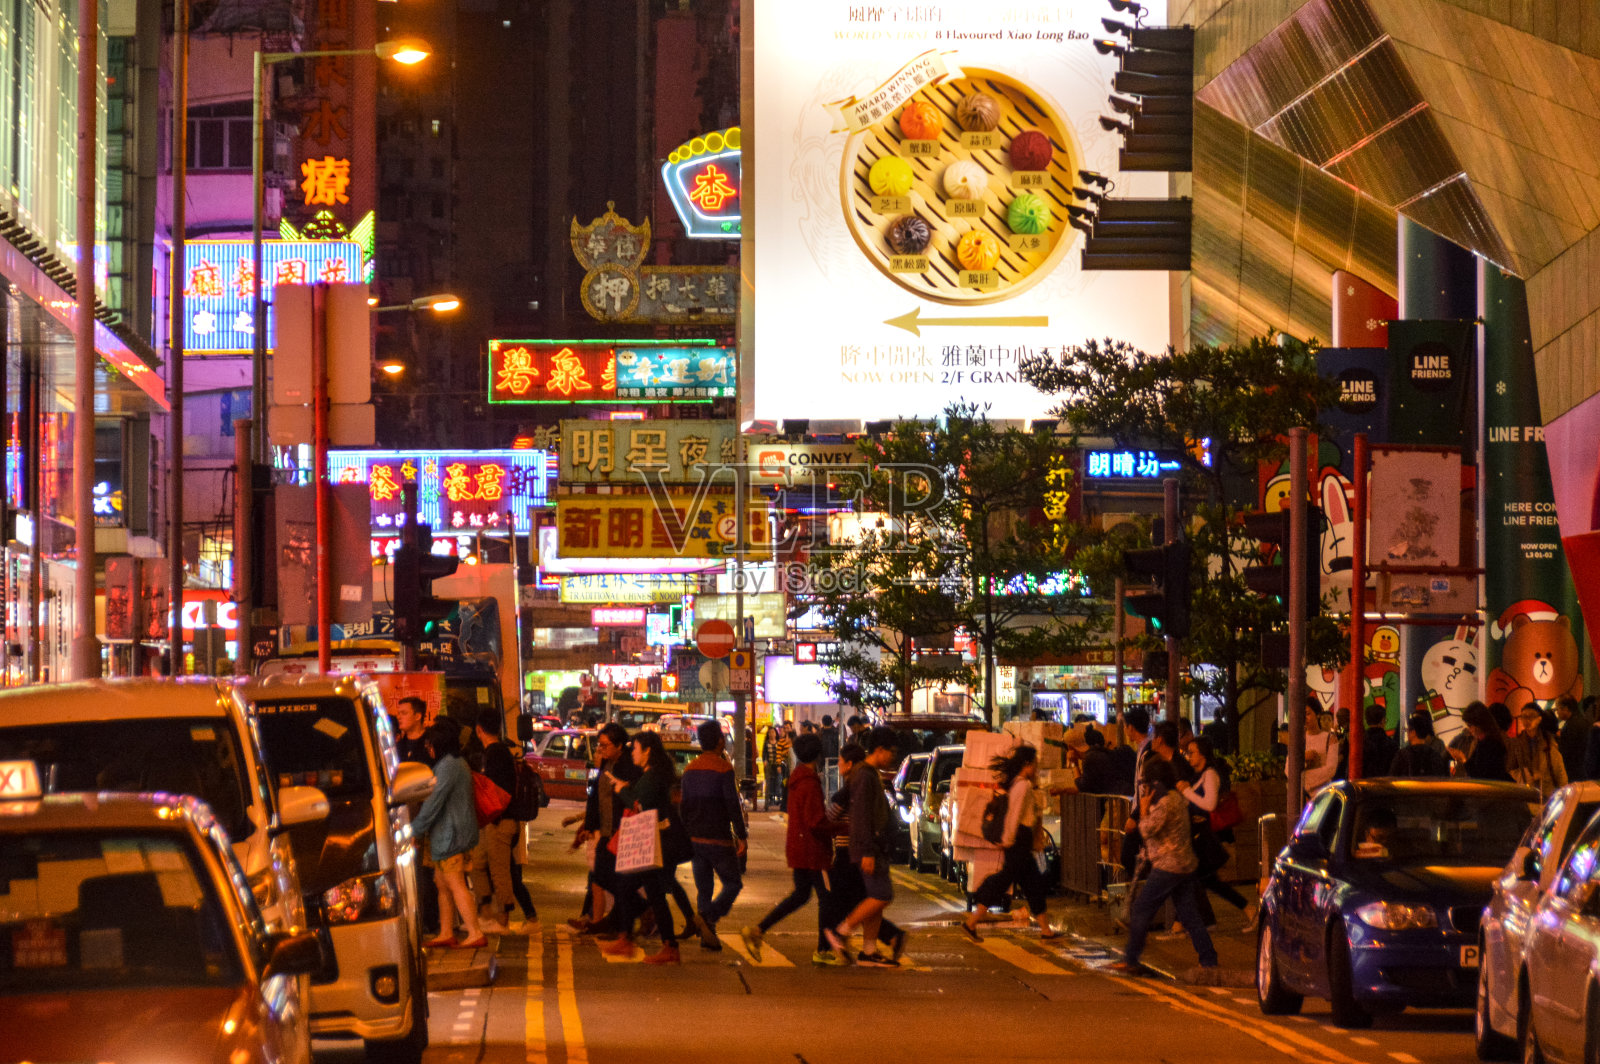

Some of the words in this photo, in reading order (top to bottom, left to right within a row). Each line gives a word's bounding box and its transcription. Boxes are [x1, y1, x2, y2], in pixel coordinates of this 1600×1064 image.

[935, 29, 942, 40] 8
[947, 29, 1003, 40] Flavoured
[1006, 29, 1032, 40] Xiao
[1036, 29, 1063, 42] Long
[1067, 29, 1089, 40] Bao
[855, 91, 887, 114] AWARD
[887, 59, 930, 92] WINNING
[690, 164, 736, 211] 杏
[954, 203, 977, 214] 原味
[594, 273, 630, 312] 押
[941, 344, 1077, 367] 雅蘭中心
[1413, 355, 1449, 369] LINE
[628, 356, 737, 387] 幸運別
[841, 371, 883, 384] NOW
[890, 371, 934, 384] OPEN
[941, 371, 965, 385] 2/F
[1411, 369, 1452, 379] FRIENDS
[1341, 380, 1374, 393] LINE
[1489, 426, 1520, 442] LINE
[788, 453, 853, 466] CONVEY
[1504, 502, 1532, 512] HERE
[563, 507, 686, 549] 新明星
[1503, 516, 1526, 526] LINE
[569, 591, 620, 601] TRADITIONAL
[623, 591, 656, 601] CHINESE
[798, 645, 813, 660] K
[279, 703, 317, 713] PIECE
[1465, 948, 1477, 965] P
